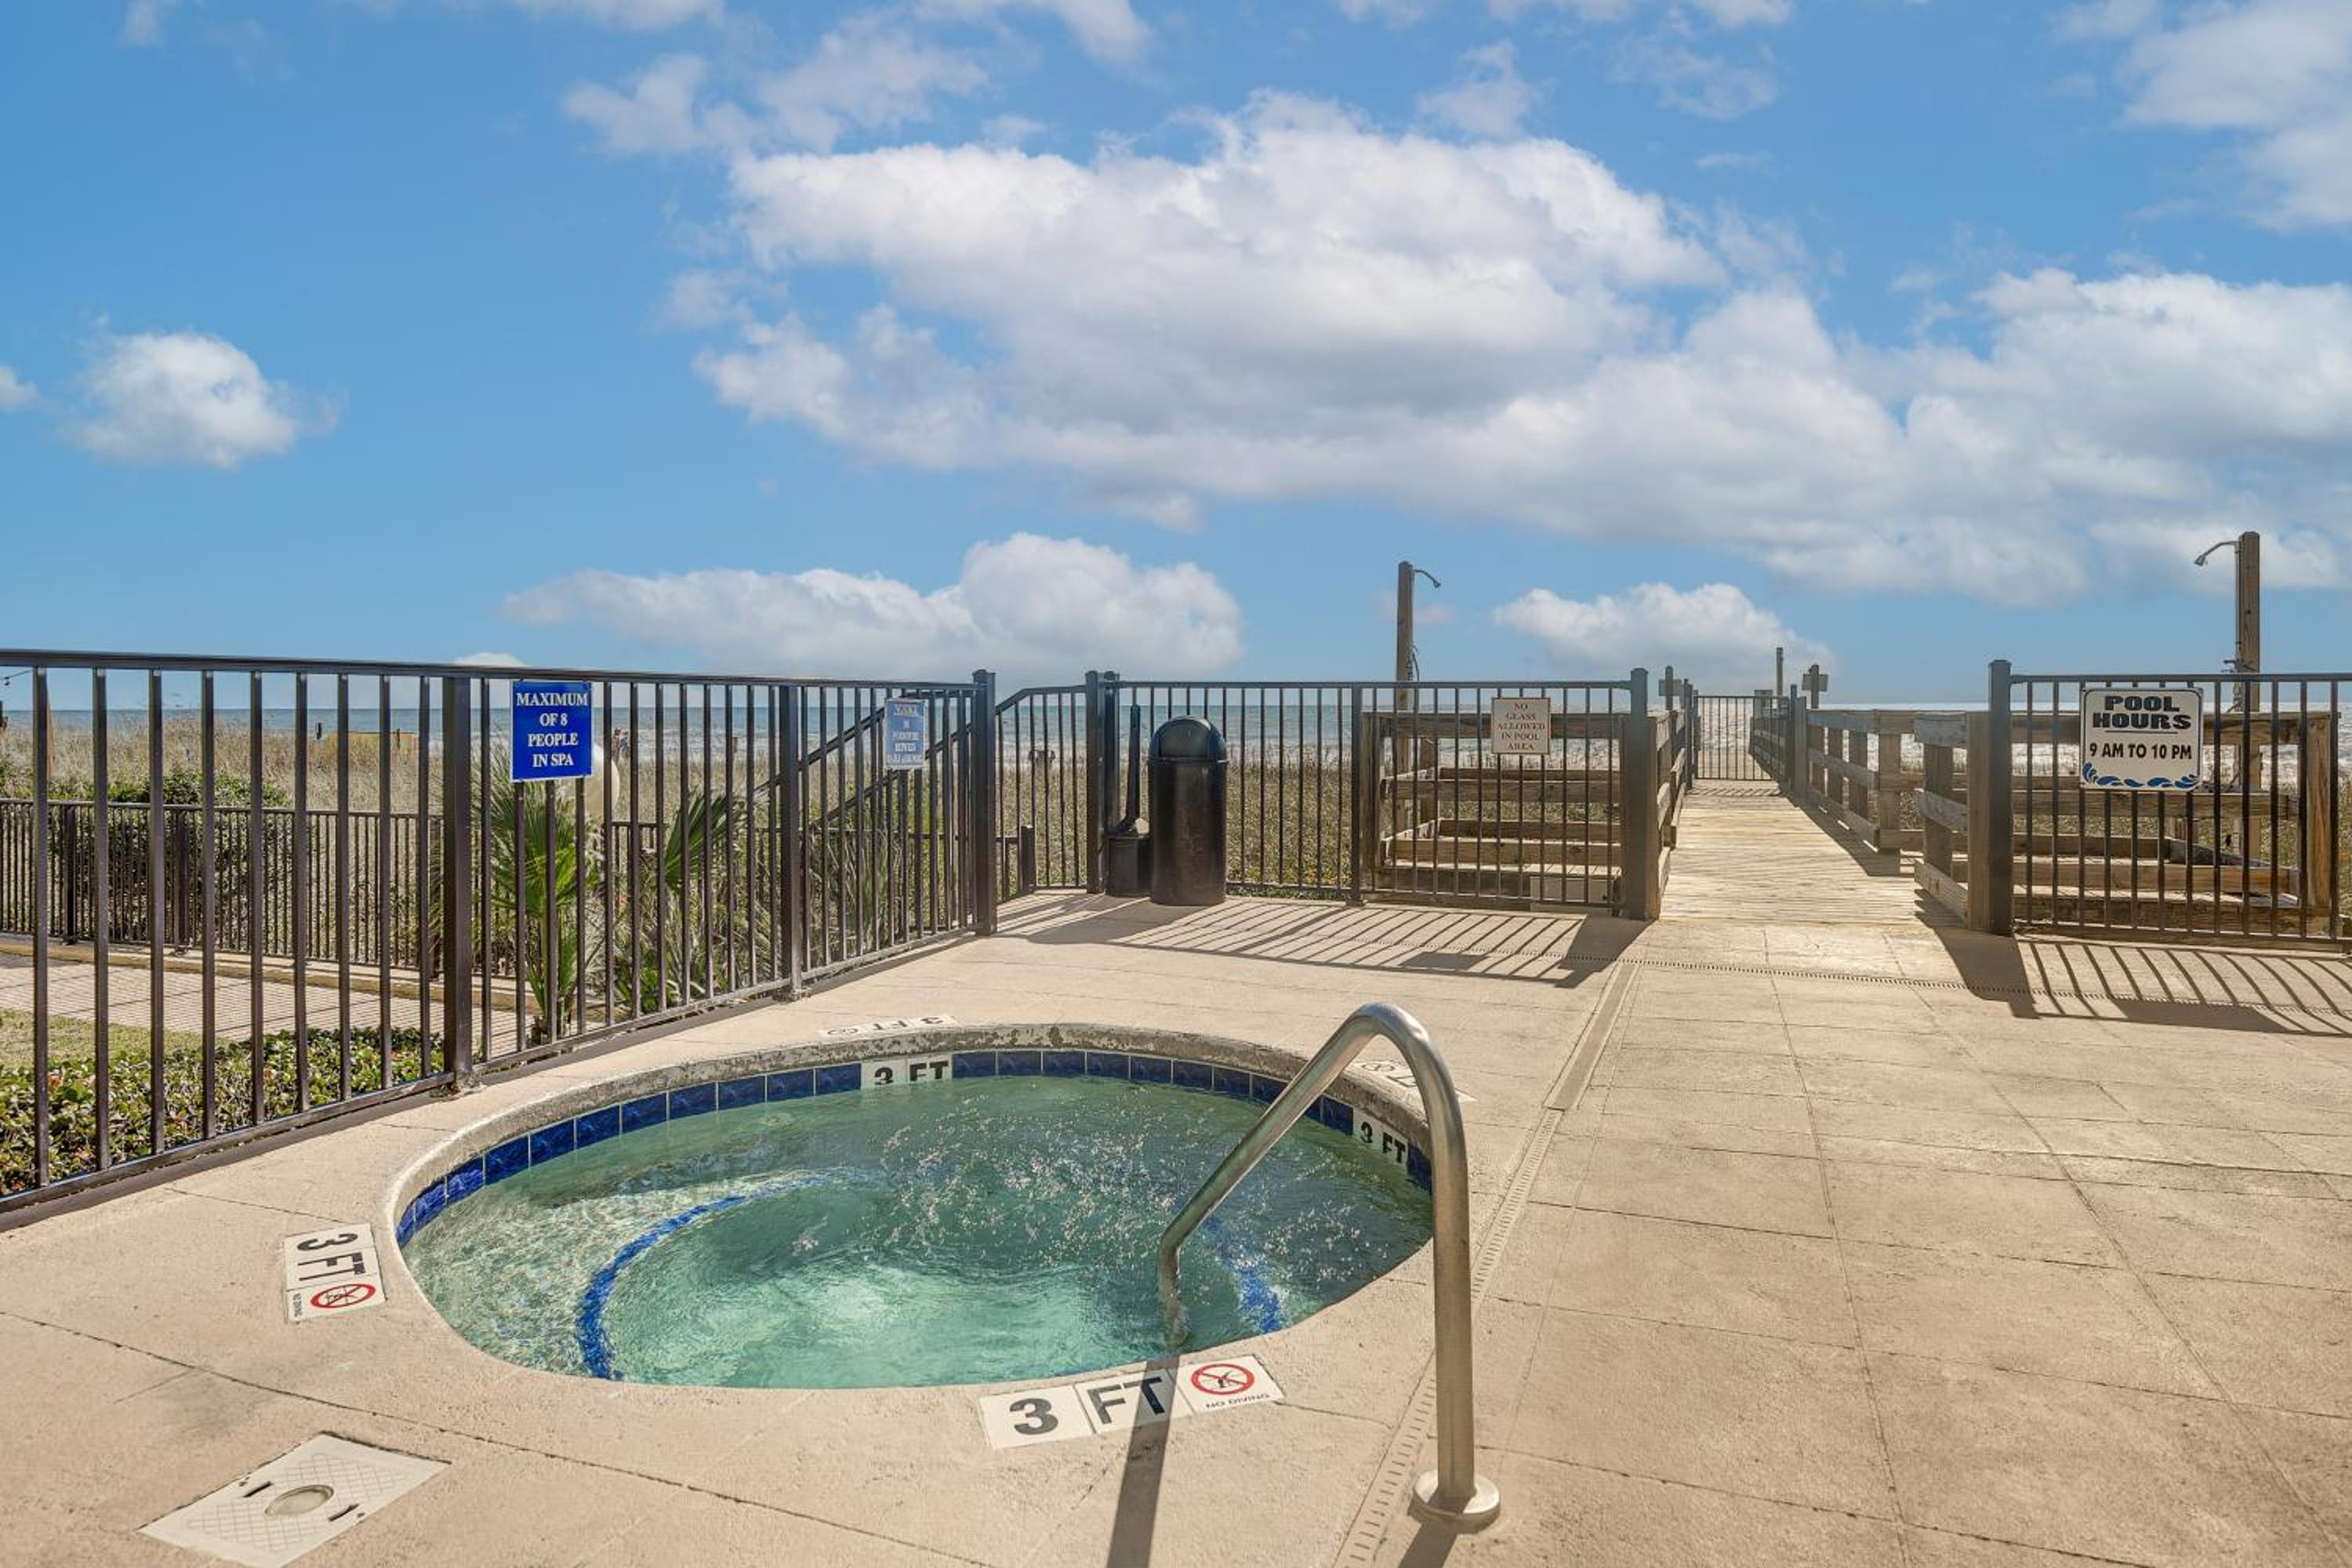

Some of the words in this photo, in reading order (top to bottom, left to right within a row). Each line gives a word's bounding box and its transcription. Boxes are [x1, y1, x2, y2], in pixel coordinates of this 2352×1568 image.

[516, 692, 589, 706] MAXIMUM
[2104, 695, 2180, 712] POOL
[539, 713, 558, 726] OF
[560, 713, 568, 726] 8
[1505, 712, 1536, 720] GLASS
[2092, 713, 2192, 730] HOURS
[528, 732, 579, 747] PEOPLE
[2089, 742, 2097, 757] 9
[2102, 743, 2124, 758] AM
[2127, 743, 2147, 758] TO
[2151, 744, 2168, 759] 10
[2171, 745, 2192, 760] PM
[532, 753, 548, 768] IN
[550, 753, 575, 766] SPA
[873, 1066, 895, 1085] 3
[909, 1060, 949, 1082] FT
[1382, 1131, 1406, 1163] FT
[296, 1233, 358, 1251] 3
[297, 1252, 366, 1281] FT
[1008, 1397, 1059, 1436] 3
[1087, 1375, 1166, 1425] FT
